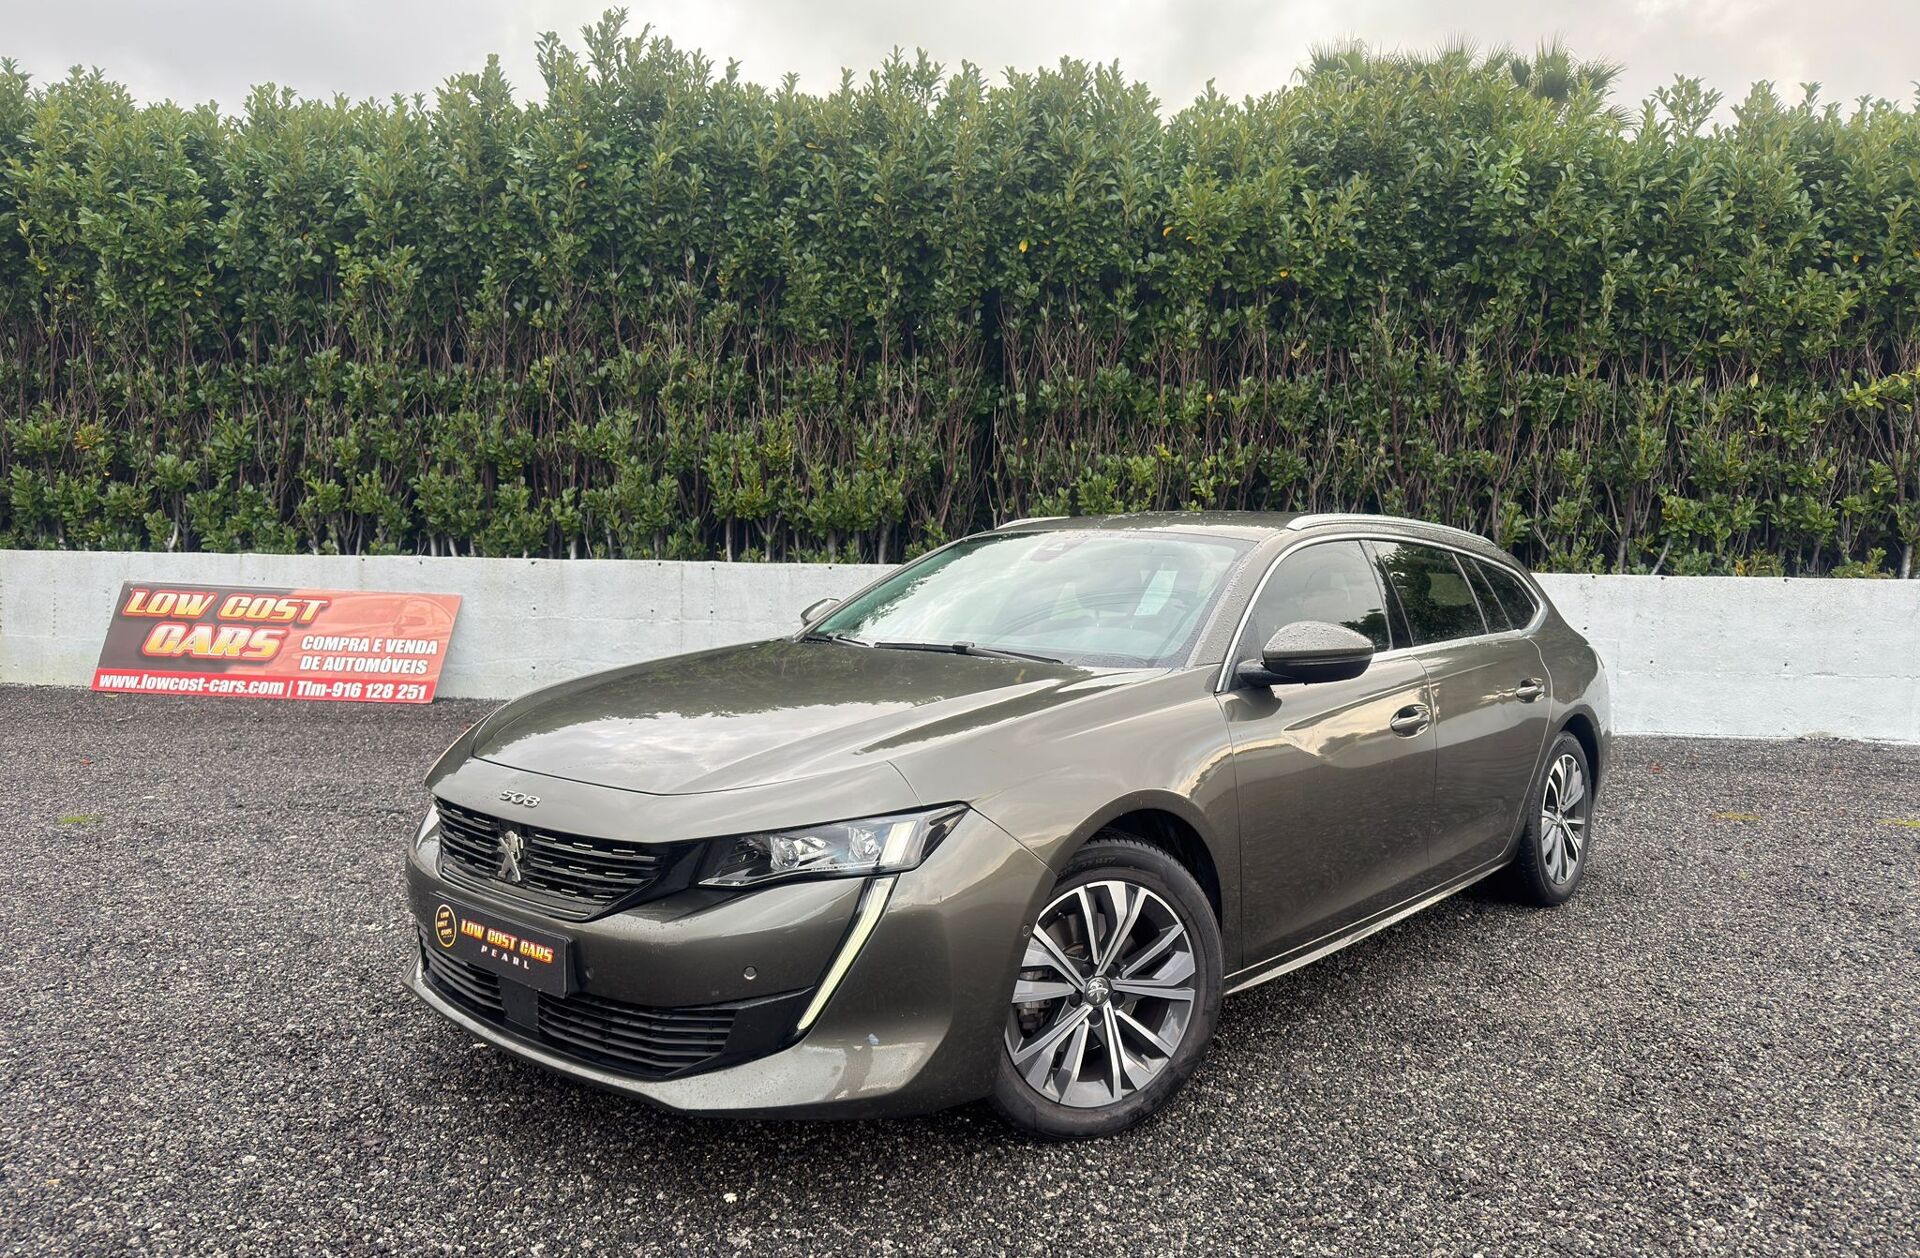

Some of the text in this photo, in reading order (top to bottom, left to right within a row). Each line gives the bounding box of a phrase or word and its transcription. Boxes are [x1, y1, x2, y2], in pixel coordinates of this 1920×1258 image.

[124, 590, 330, 622] LOW COST
[144, 623, 289, 659] CARS
[301, 635, 439, 655] COMPRA E VENDA
[300, 654, 428, 675] DE AUTOMÓVEIS
[99, 673, 285, 695] www.lowcost-cars.com
[365, 683, 394, 698] 128
[396, 684, 427, 700] 251
[499, 789, 541, 808] 508
[461, 918, 555, 965] LOW COST CARS
[480, 944, 530, 970] PEARL
